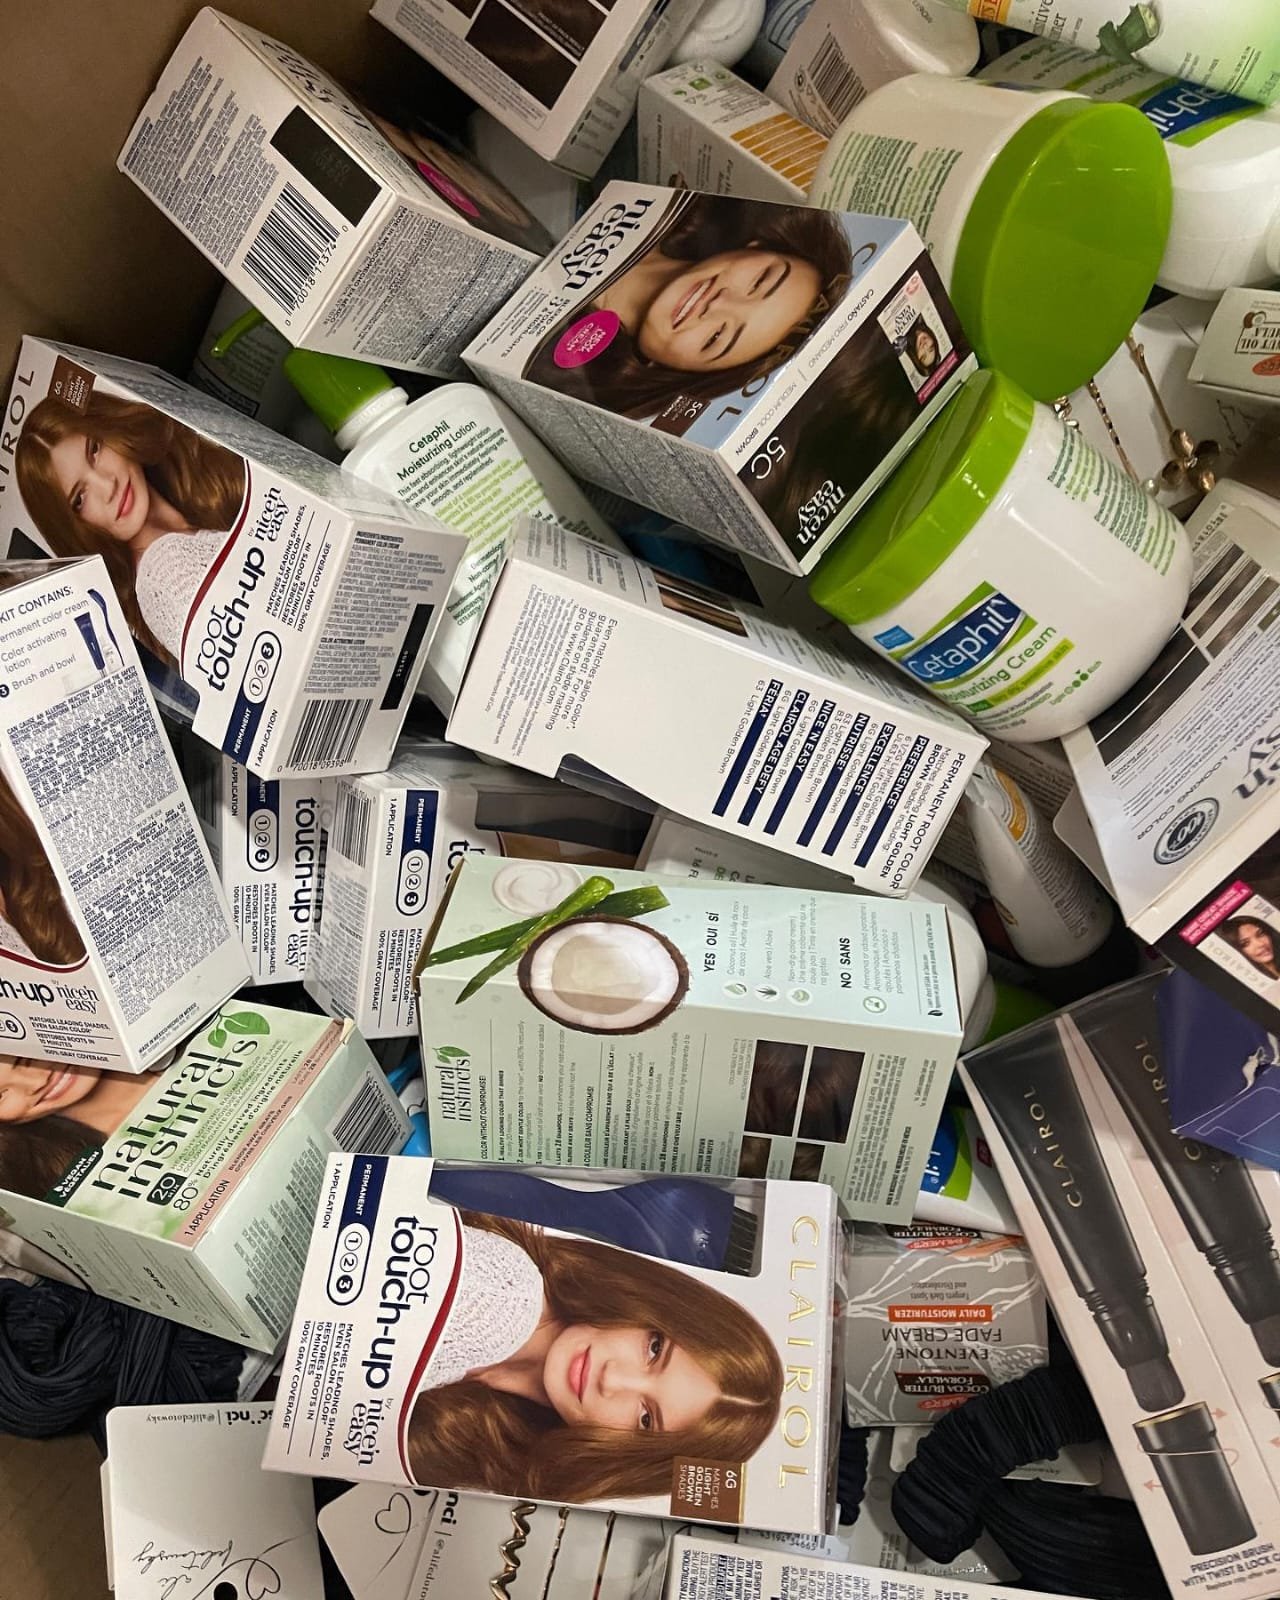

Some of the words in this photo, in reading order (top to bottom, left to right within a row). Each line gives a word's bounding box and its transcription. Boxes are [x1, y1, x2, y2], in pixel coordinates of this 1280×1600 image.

[562, 205, 627, 281] easy
[395, 434, 454, 483] Moisturizing
[448, 417, 478, 443] Lotion
[406, 418, 451, 456] Cetaphil
[733, 425, 761, 458] BROWN
[745, 432, 790, 484] 5C
[262, 495, 293, 543] easy
[789, 473, 837, 534] easy
[264, 576, 283, 614] MATCHES
[276, 539, 295, 576] LEADING
[270, 594, 283, 617] EVEN
[277, 566, 292, 594] SALON
[294, 611, 308, 632] 100%
[302, 588, 316, 611] GRAY
[309, 541, 333, 587] COVERAGE
[16, 583, 74, 615] CONTAINS:
[576, 607, 587, 621] go
[0, 619, 42, 643] ermanent
[40, 608, 63, 625] color
[62, 598, 89, 615] cream
[193, 603, 228, 674] root
[206, 548, 265, 692] touch-up
[574, 611, 598, 652] guidance
[602, 619, 618, 641] Even
[906, 599, 1014, 679] Cetaphil
[0, 645, 25, 663] Color
[24, 626, 68, 652] activating
[587, 641, 609, 680] matches
[1003, 624, 1062, 673] Cream
[4, 656, 31, 674] lotion
[11, 672, 39, 690] Brush
[37, 664, 56, 678] and
[54, 654, 77, 672] bowl
[544, 633, 580, 705] www.Clairol.com
[560, 665, 576, 691] shade
[578, 679, 594, 703] salon
[230, 707, 253, 754] PERMANENT
[543, 691, 567, 731] matching
[777, 690, 807, 739] CLAIROL
[811, 700, 835, 733] NICE
[254, 708, 279, 762] APPLICATION
[765, 739, 784, 764] AGE
[854, 734, 873, 759] Light
[794, 742, 815, 773] EASY
[841, 758, 861, 788] Golden
[918, 742, 943, 781] BROWN
[927, 745, 951, 783] Matches
[752, 763, 773, 793] DEFY
[910, 781, 933, 814] leading
[925, 751, 966, 820] PERMANENT
[413, 798, 423, 843] PERMANENT
[828, 787, 847, 815] Brown
[383, 803, 395, 856] APPLICATION
[898, 812, 917, 840] LIGHT
[908, 820, 931, 852] ROOT
[1135, 801, 1176, 844] COLOR
[878, 840, 903, 879] GOLDEN
[888, 850, 914, 890] COLOR
[269, 883, 277, 913] MATCHES
[268, 915, 277, 945] LEADING
[705, 928, 717, 945] OUI
[284, 933, 301, 970] easy
[703, 952, 716, 971] YES
[838, 937, 851, 965] SANS
[840, 972, 852, 988] NO
[226, 1100, 253, 1134] derived
[252, 1056, 289, 1102] ingredients
[434, 1066, 455, 1120] natural
[451, 1059, 471, 1122] instincts
[91, 1050, 218, 1191] natural
[117, 1038, 258, 1198] instincts
[195, 1134, 233, 1179] Naturally
[1023, 1084, 1084, 1209] CLAIROL
[151, 1173, 177, 1203] 20
[186, 1176, 232, 1231] APPLICATION
[321, 1168, 340, 1229] APPLICATION
[354, 1162, 372, 1215] PERMANENT
[404, 1224, 440, 1306] root
[361, 1216, 418, 1391] touch-up
[892, 1308, 955, 1318] MOISTURIZER
[958, 1308, 985, 1318] DAILY
[299, 1319, 310, 1345] 100%
[316, 1321, 332, 1369] RESTORES
[334, 1322, 345, 1348] EVEN
[338, 1323, 353, 1368] MATCHES
[881, 1327, 947, 1341] CREAM
[953, 1327, 1000, 1341] FADE
[292, 1345, 304, 1373] GRAY
[306, 1332, 322, 1377] MINUTES
[326, 1350, 340, 1384] SALON
[778, 1215, 821, 1490] CLAIROL
[894, 1346, 988, 1359] EVENTONE
[280, 1374, 299, 1430] COVERAGE
[308, 1371, 322, 1406] ROOTS
[329, 1369, 345, 1415] LEADING
[903, 1384, 944, 1393] BUTTER
[947, 1384, 989, 1393] COCOA
[319, 1416, 336, 1462] SHADES,
[342, 1401, 371, 1456] easy
[676, 1463, 687, 1500] SHADES
[685, 1465, 696, 1502] BROWN
[693, 1466, 705, 1506] GOLDEN
[702, 1466, 712, 1496] LIGHT
[709, 1467, 721, 1510] MATCHES
[724, 1469, 738, 1489] 6G
[1190, 1552, 1241, 1573] PRECISION
